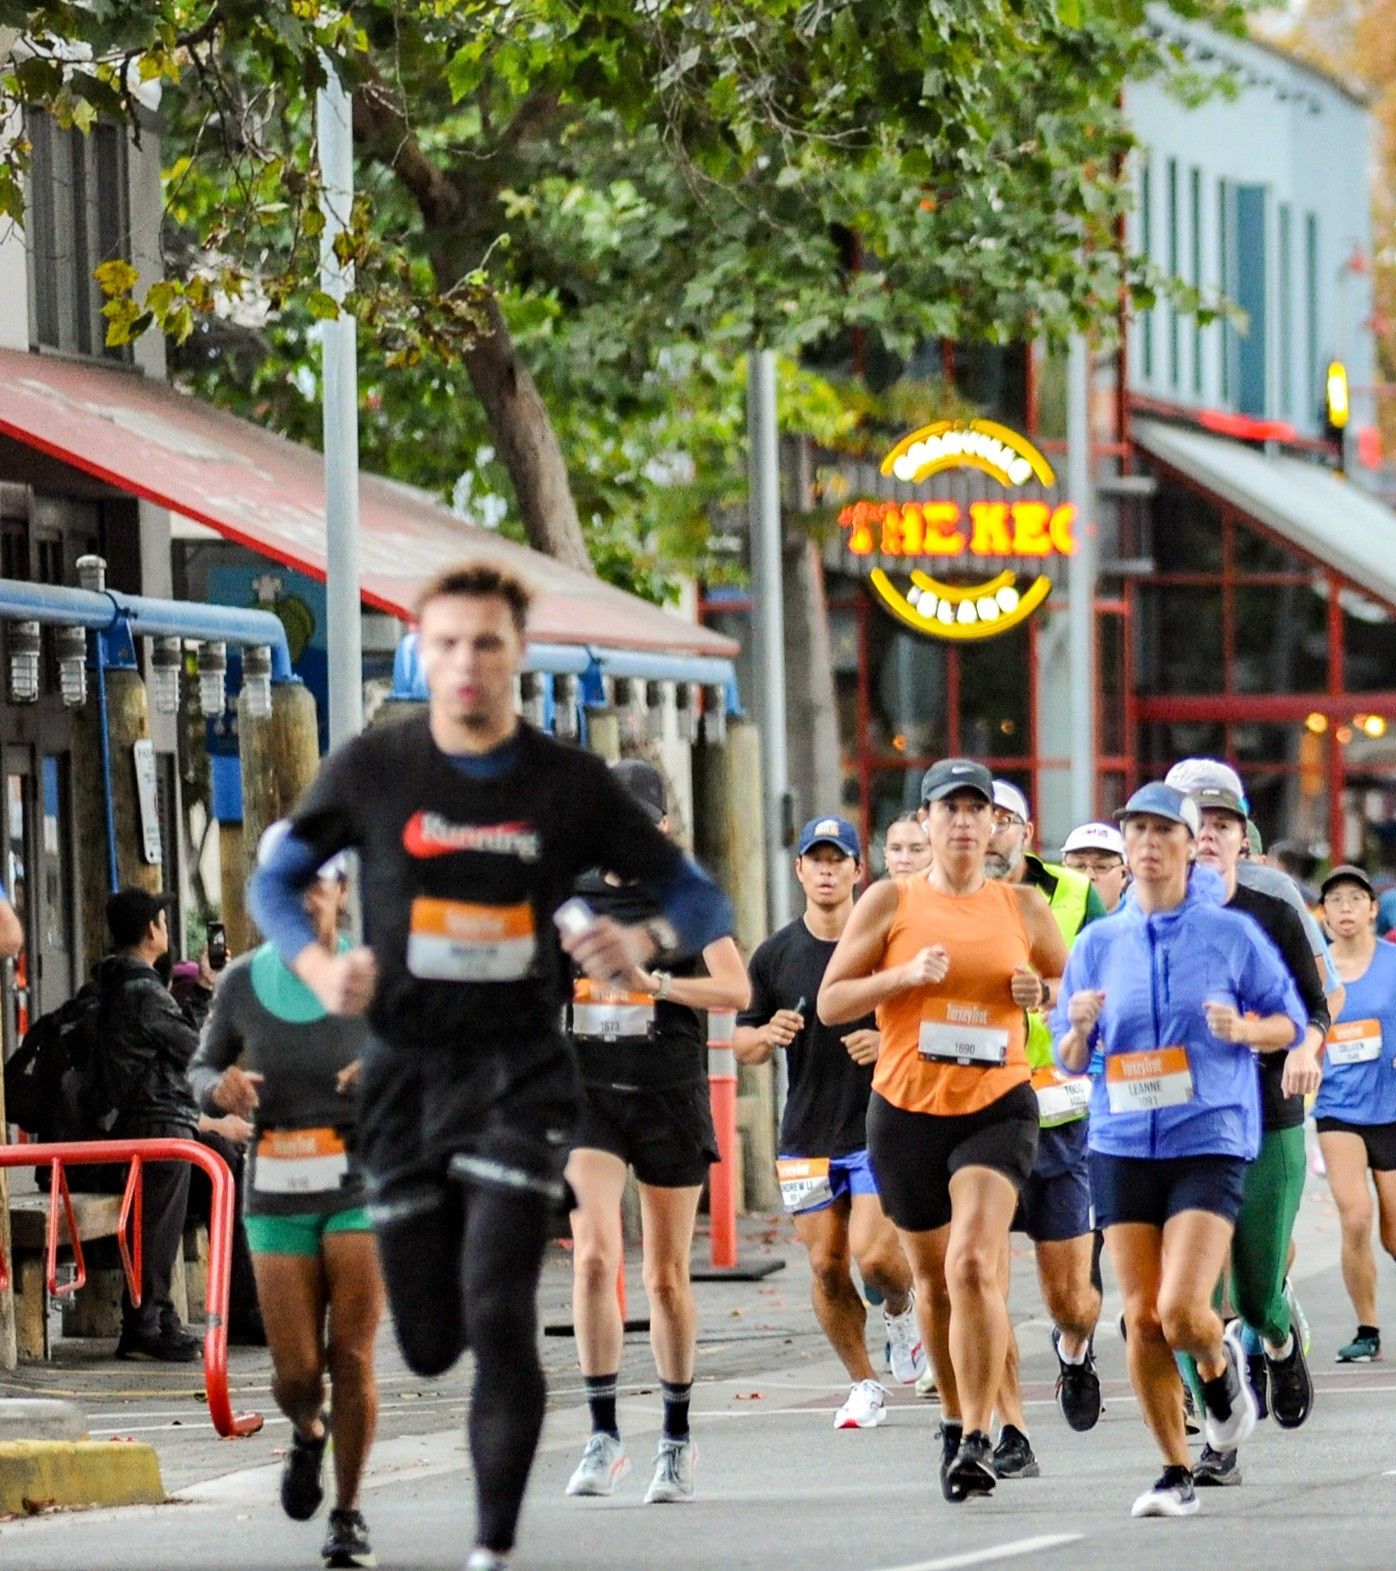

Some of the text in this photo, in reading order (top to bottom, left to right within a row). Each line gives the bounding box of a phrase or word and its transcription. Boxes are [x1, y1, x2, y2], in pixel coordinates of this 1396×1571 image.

[839, 501, 965, 556] THE
[421, 812, 542, 864] Running
[955, 1042, 976, 1056] 1690
[1128, 1080, 1162, 1096] LEANNE
[781, 1180, 805, 1193] NDREW
